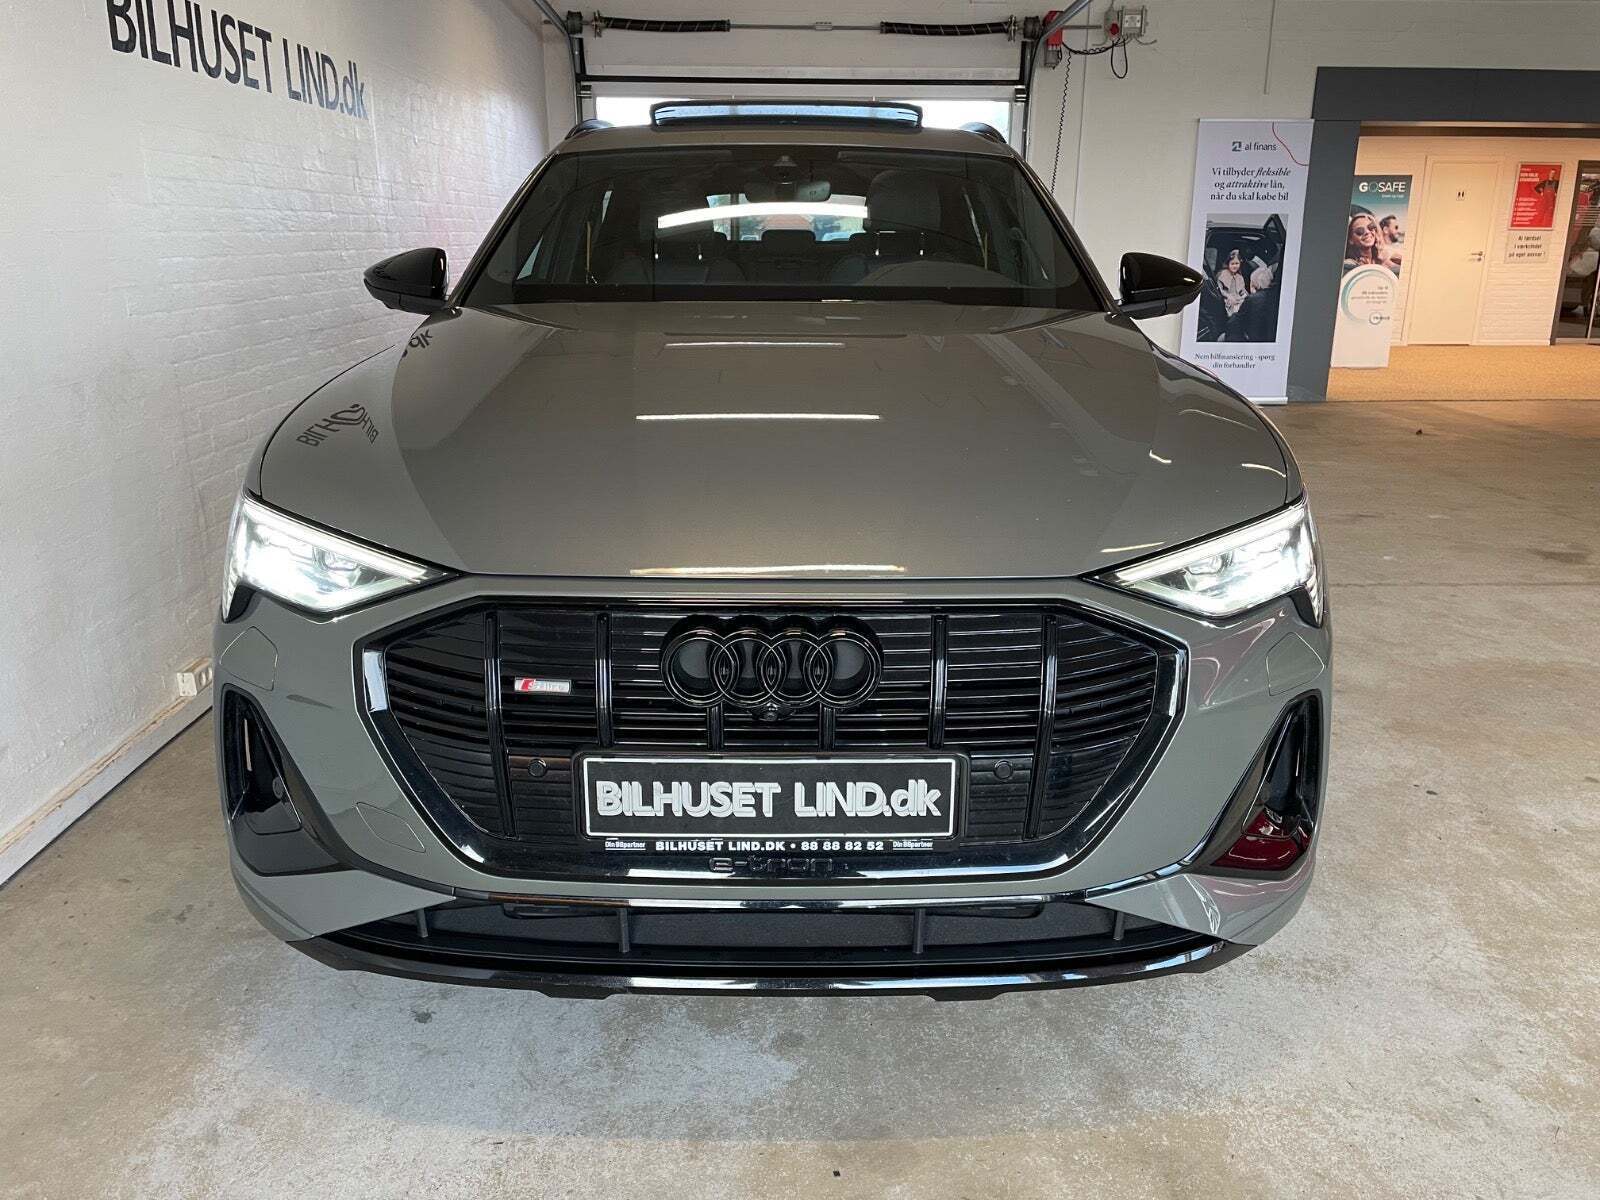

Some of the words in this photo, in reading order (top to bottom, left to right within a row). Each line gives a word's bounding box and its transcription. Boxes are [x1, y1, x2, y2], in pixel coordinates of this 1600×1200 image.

[107, 0, 272, 93] BILHUSET
[282, 38, 369, 120] LIND.dk
[1244, 142, 1252, 151] al
[1253, 142, 1277, 151] finans
[1212, 167, 1221, 176] Vi
[1222, 167, 1255, 178] tilbyder
[1254, 167, 1291, 178] fleksible
[1214, 181, 1225, 190] og
[1226, 180, 1269, 188] attraktive
[1210, 192, 1224, 200] når
[1225, 192, 1237, 200] du
[1238, 192, 1255, 200] skal
[1256, 192, 1276, 200] købe
[1278, 192, 1289, 200] bil
[596, 780, 782, 818] BILHUSET
[794, 779, 942, 817] LIND.dk
[655, 841, 724, 851] BILHUSET
[728, 841, 786, 851] LIND.DK
[866, 841, 884, 851] 52
